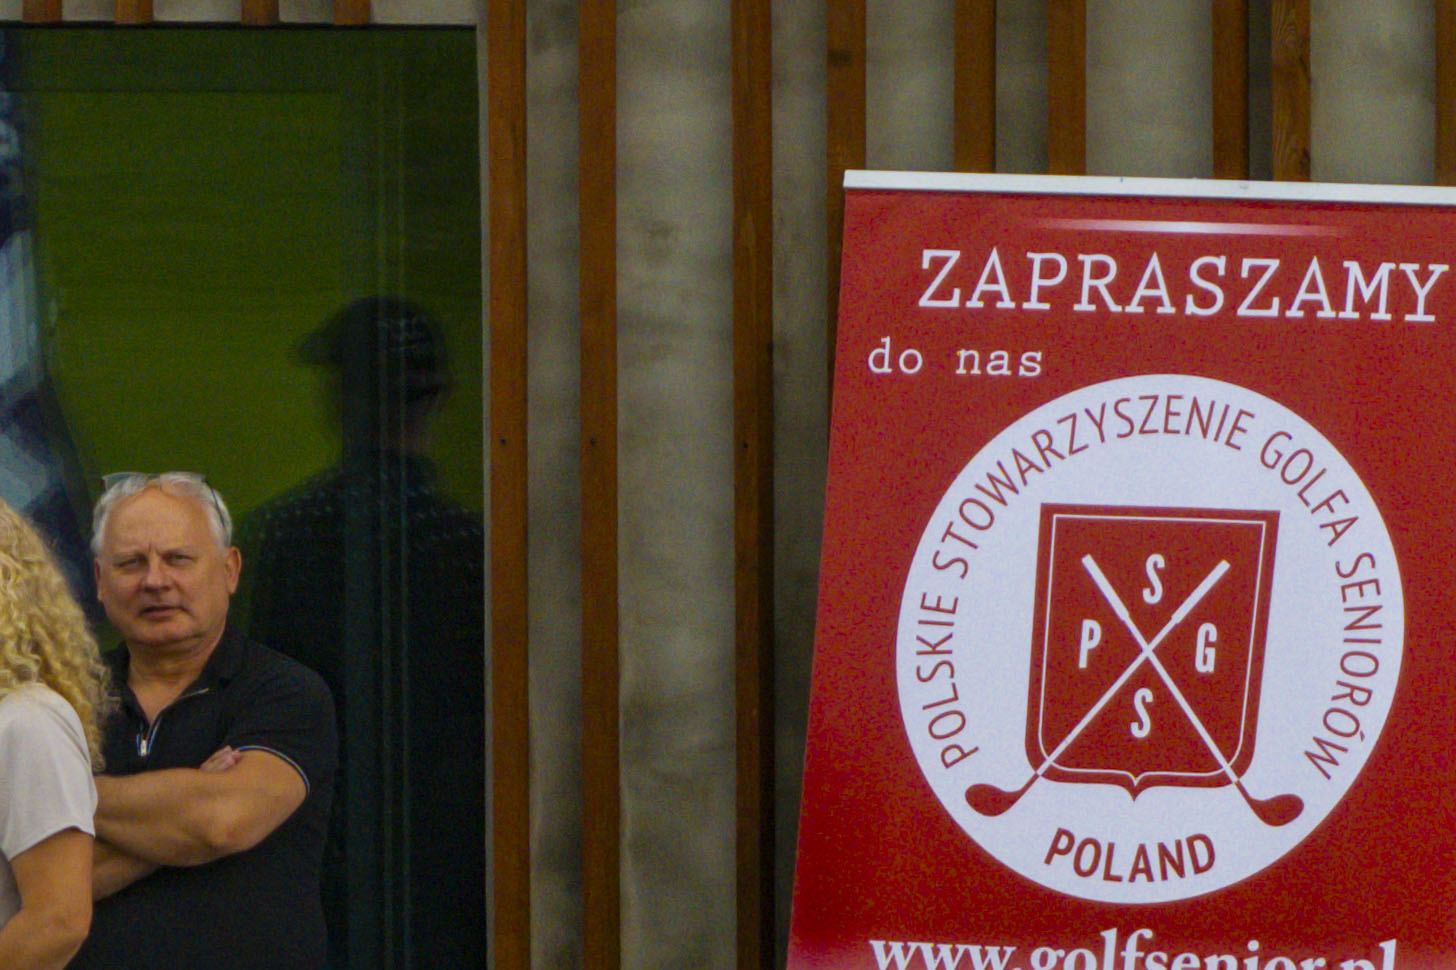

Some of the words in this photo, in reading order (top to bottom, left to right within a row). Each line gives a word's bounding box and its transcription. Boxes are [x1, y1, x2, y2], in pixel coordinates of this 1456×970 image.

[918, 246, 1450, 323] ZAPRASZAMY
[867, 336, 923, 375] do
[955, 348, 1043, 377] nas
[932, 394, 1256, 580] STOWARZYSZENIE
[1259, 430, 1360, 548] GOLFA
[1142, 553, 1166, 605] S
[1077, 618, 1102, 669] P
[1194, 621, 1218, 674] G
[1303, 551, 1384, 781] SENIORÓW
[915, 591, 980, 769] POLSKIE
[1129, 687, 1154, 739] S
[1043, 826, 1217, 883] POLAND
